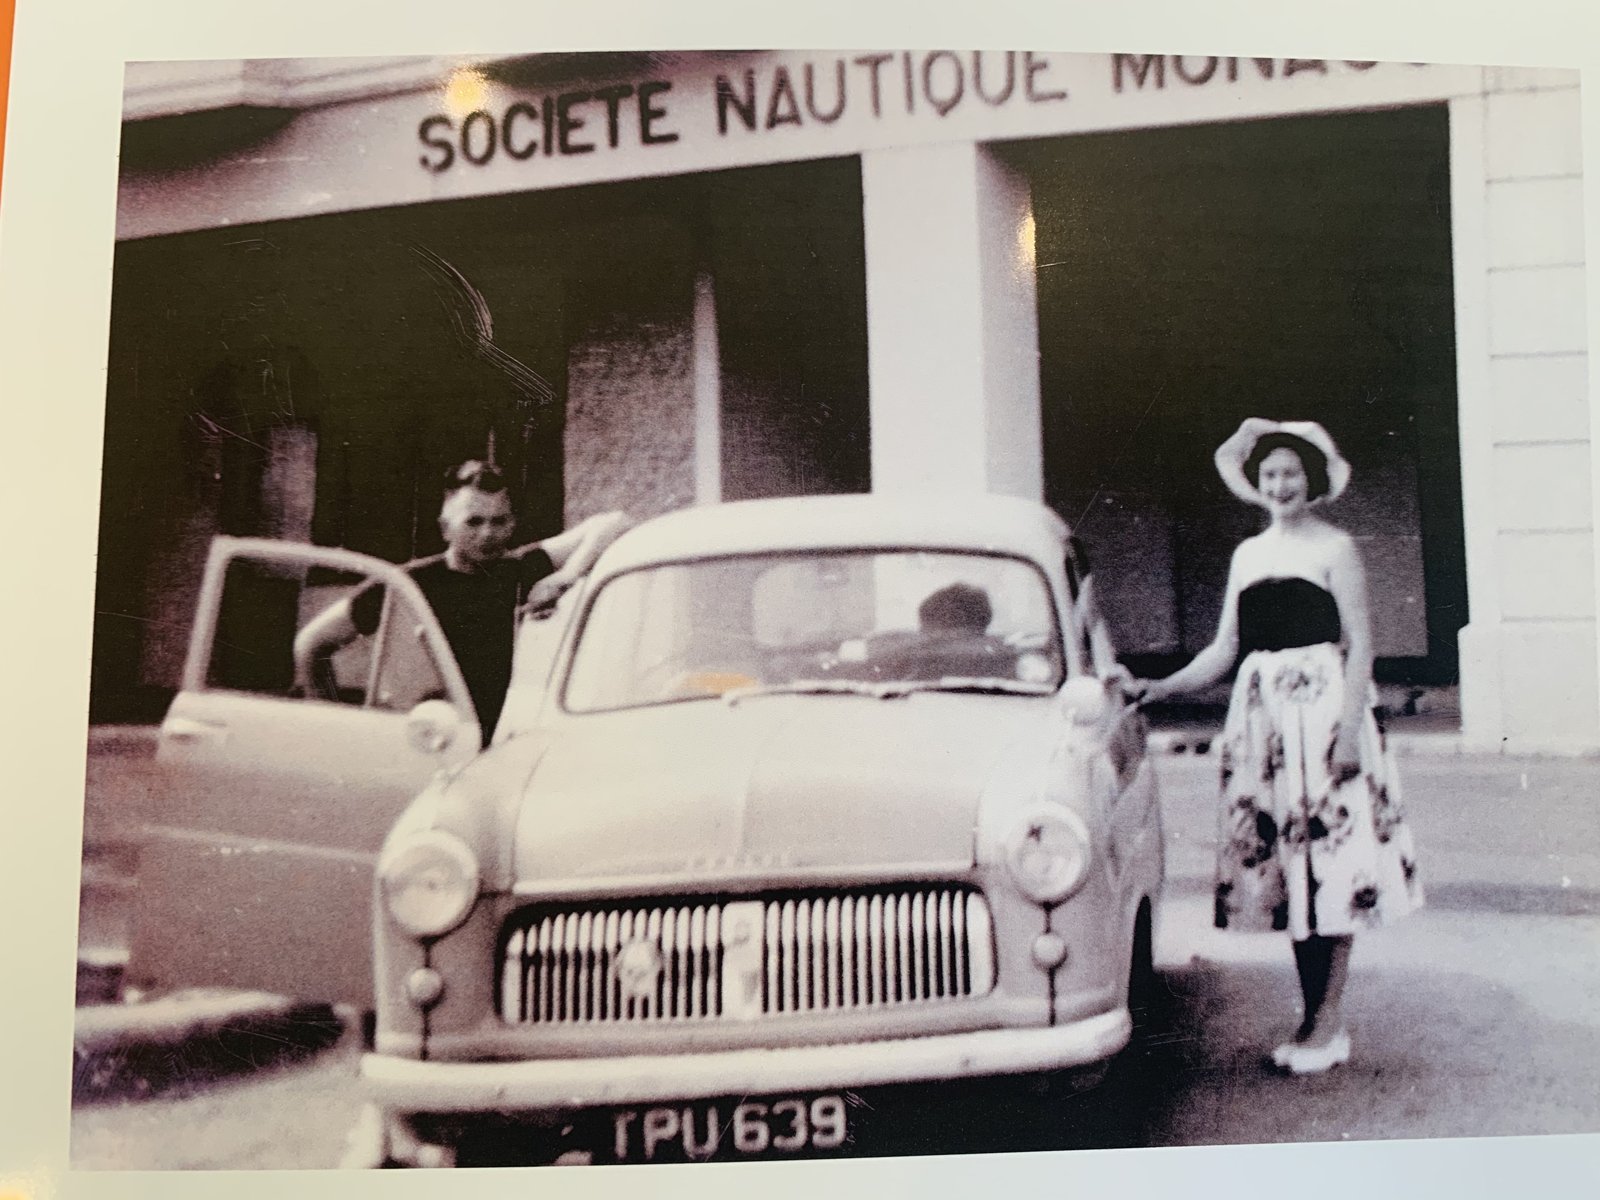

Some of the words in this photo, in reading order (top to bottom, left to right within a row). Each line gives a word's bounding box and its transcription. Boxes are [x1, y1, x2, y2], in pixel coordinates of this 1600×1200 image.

[418, 81, 679, 172] SOCIETE
[714, 51, 1068, 135] NAUTIQUE
[733, 1096, 847, 1152] 639
